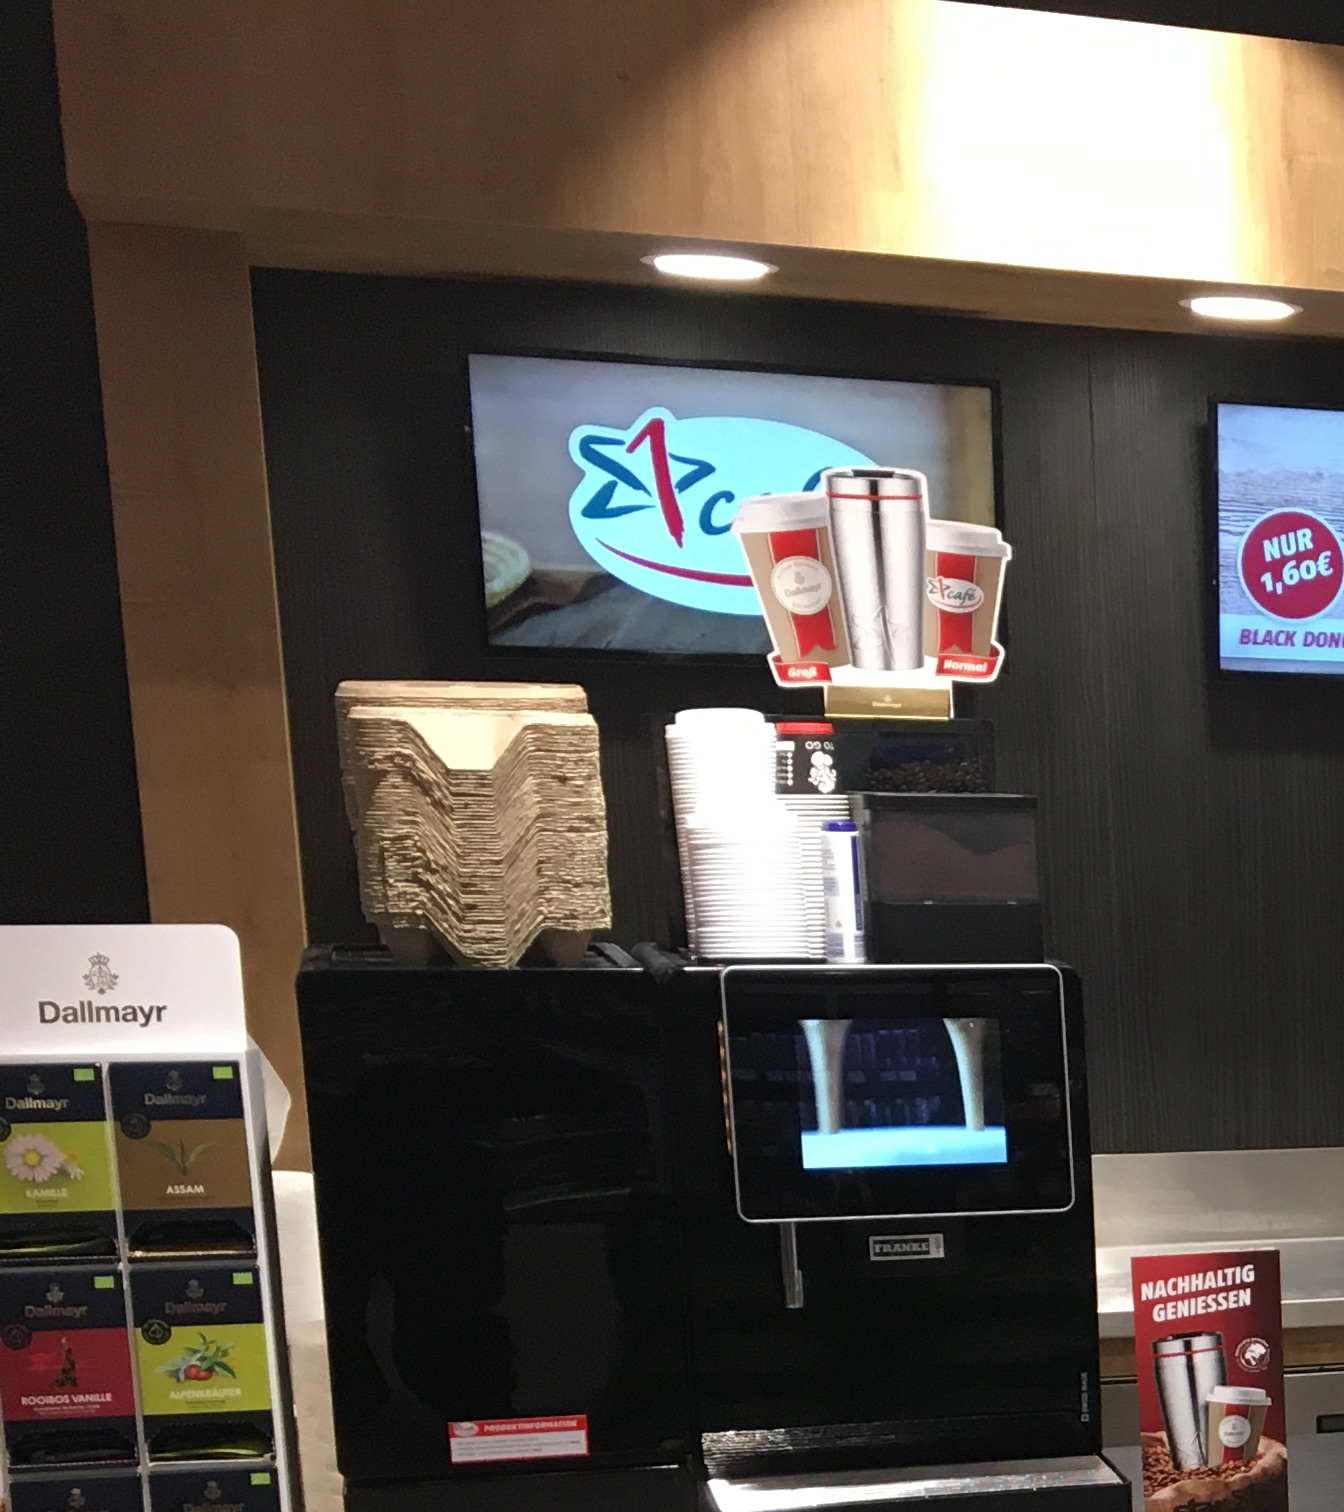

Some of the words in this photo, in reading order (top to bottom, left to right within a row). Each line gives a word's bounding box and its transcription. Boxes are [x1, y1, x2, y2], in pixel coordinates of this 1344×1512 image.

[1262, 528, 1314, 563] NUR
[1260, 551, 1334, 595] 1,60€
[946, 587, 978, 606] café
[1239, 628, 1297, 649] BLACK
[943, 659, 988, 673] Normal
[788, 667, 817, 680] Groß
[804, 740, 822, 751] GO
[38, 1000, 167, 1027] Dallmayr
[5, 1096, 69, 1110] Dallmayr
[144, 1092, 207, 1106] Dallmayr
[166, 1184, 204, 1194] ASSAM
[874, 1242, 929, 1253] FRANKE
[1141, 1263, 1255, 1302] NACHHALTIG
[25, 1304, 88, 1318] Dallmayr
[1152, 1288, 1251, 1322] GENIESSEN
[21, 1394, 70, 1406] ROOIBOS
[71, 1392, 112, 1403] VANILLE
